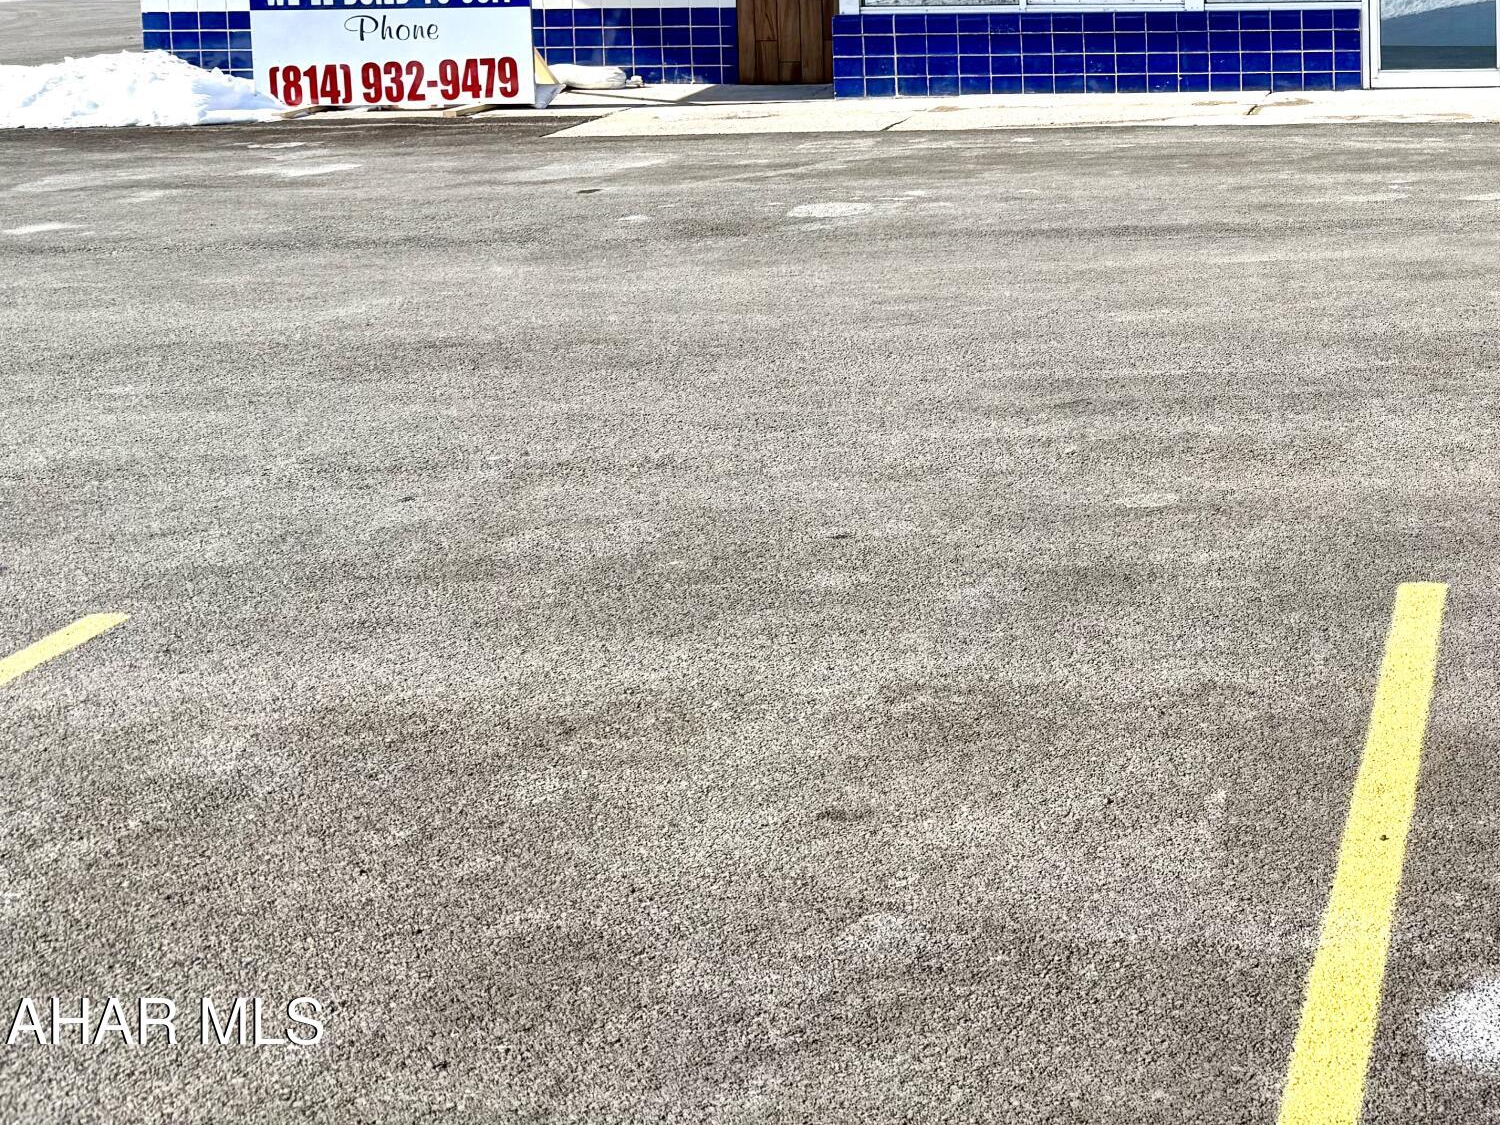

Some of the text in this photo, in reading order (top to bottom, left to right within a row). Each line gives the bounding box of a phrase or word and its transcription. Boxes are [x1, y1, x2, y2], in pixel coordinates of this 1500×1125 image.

[344, 15, 439, 41] Phone
[268, 56, 519, 107] (814) 932-9479
